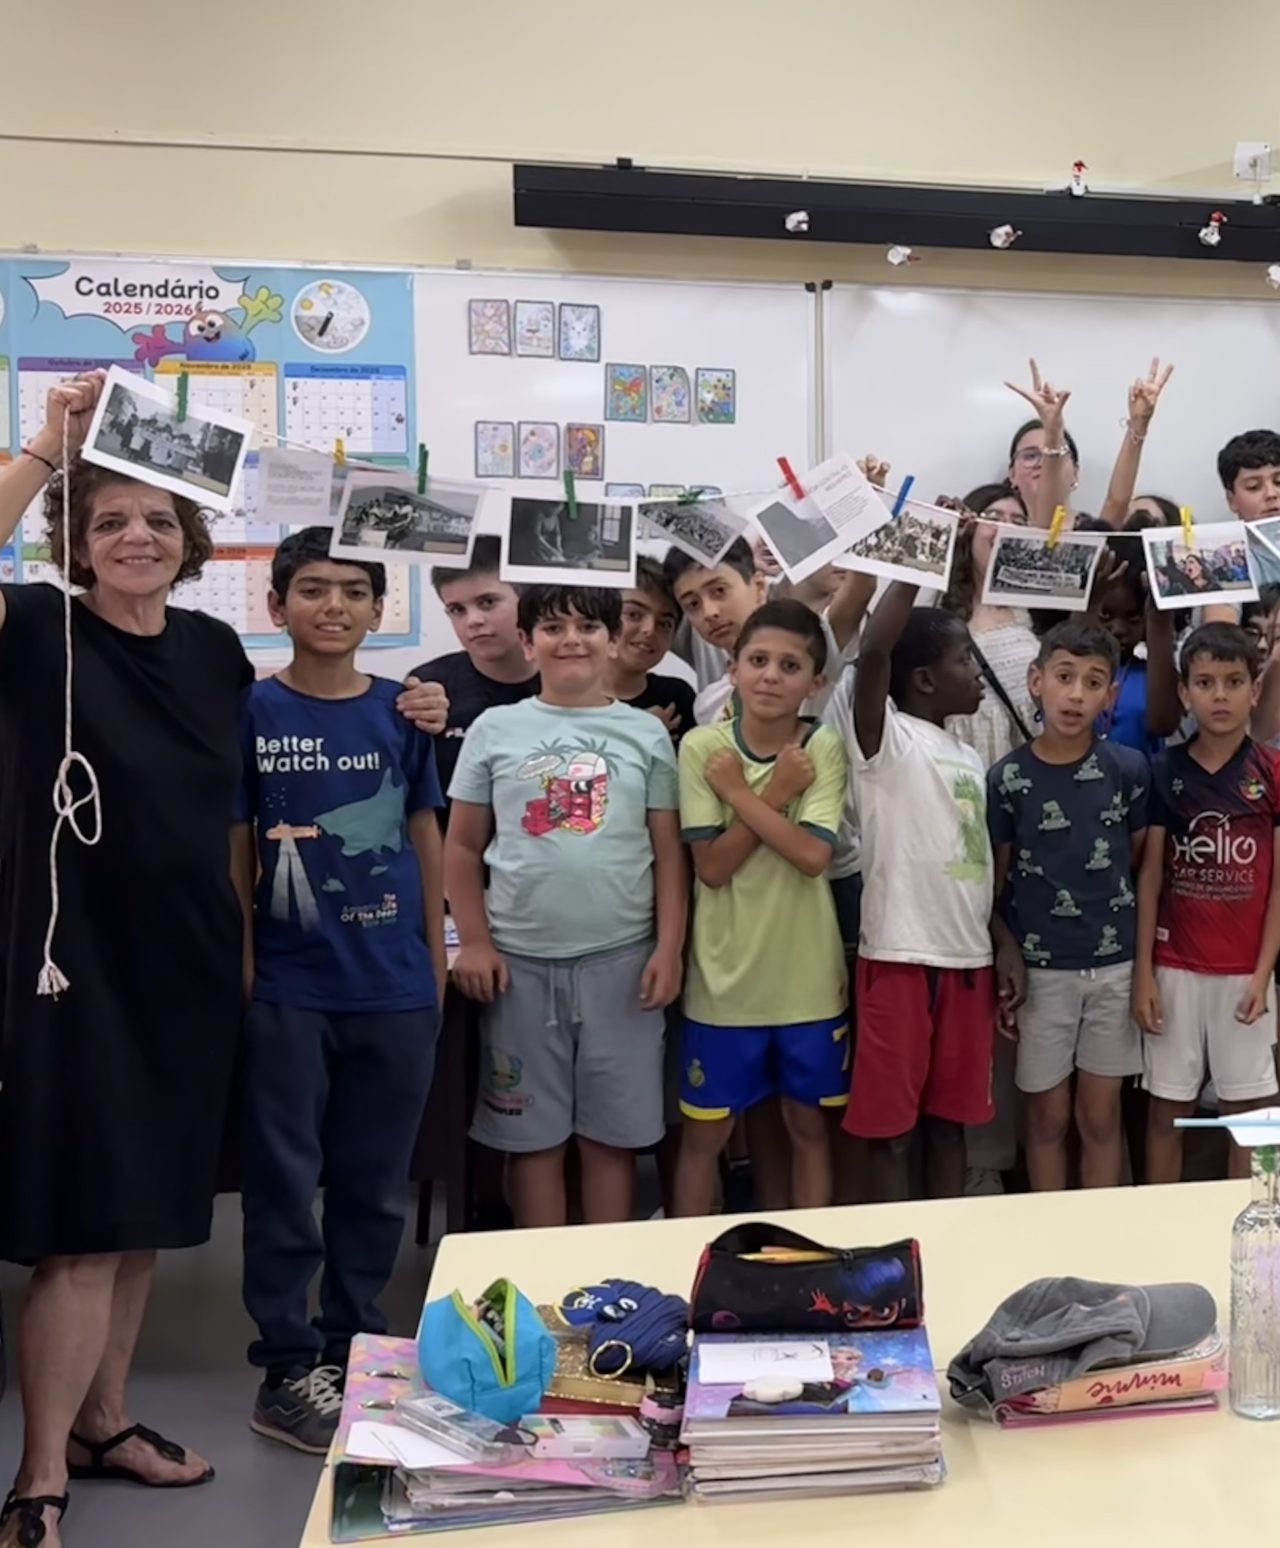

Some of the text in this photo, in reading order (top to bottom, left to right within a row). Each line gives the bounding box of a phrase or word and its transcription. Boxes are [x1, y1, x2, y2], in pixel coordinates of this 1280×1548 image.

[75, 276, 220, 300] Calendário
[103, 301, 143, 314] 2025
[154, 303, 194, 316] 2026
[256, 736, 325, 754] Better
[257, 752, 380, 773] Watch out!
[1199, 867, 1255, 884] SERVICE
